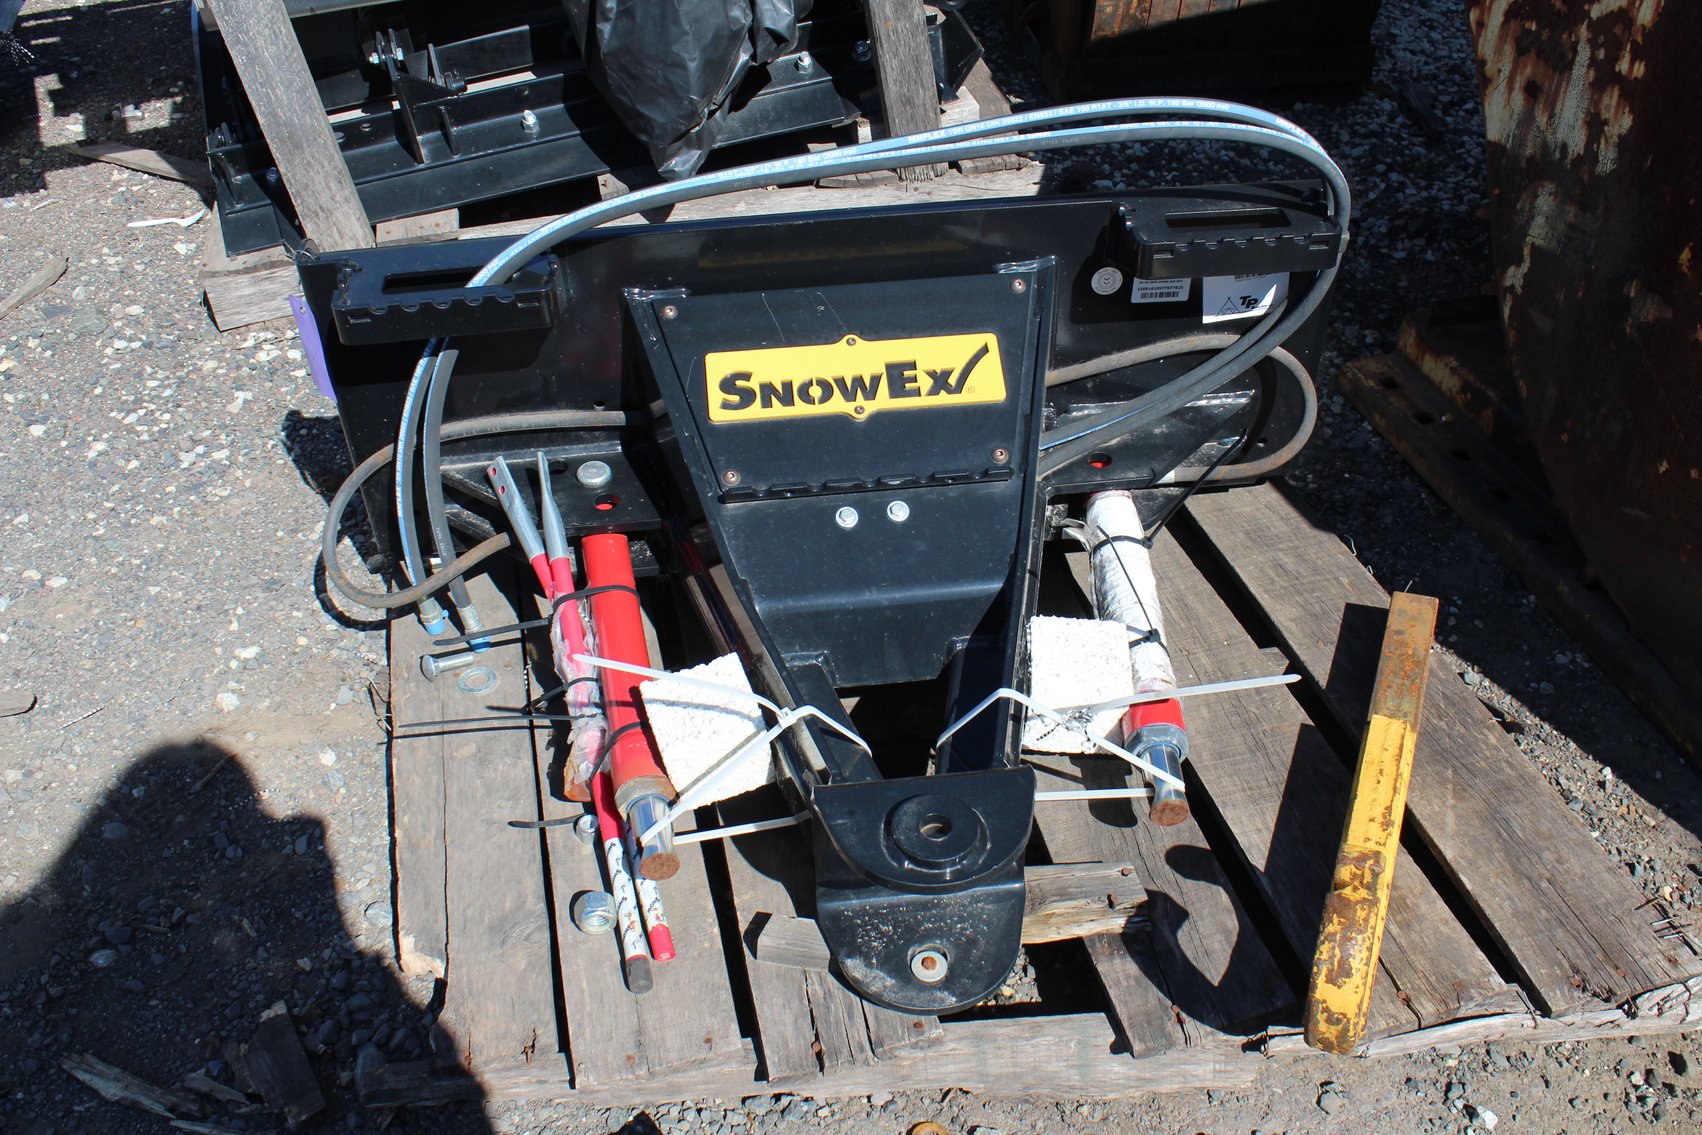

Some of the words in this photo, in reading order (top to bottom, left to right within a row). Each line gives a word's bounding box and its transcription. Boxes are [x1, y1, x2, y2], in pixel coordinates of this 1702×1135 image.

[966, 123, 985, 132] DN10
[1077, 104, 1090, 112] 100
[1182, 99, 1194, 107] Bar
[1239, 295, 1259, 309] TP
